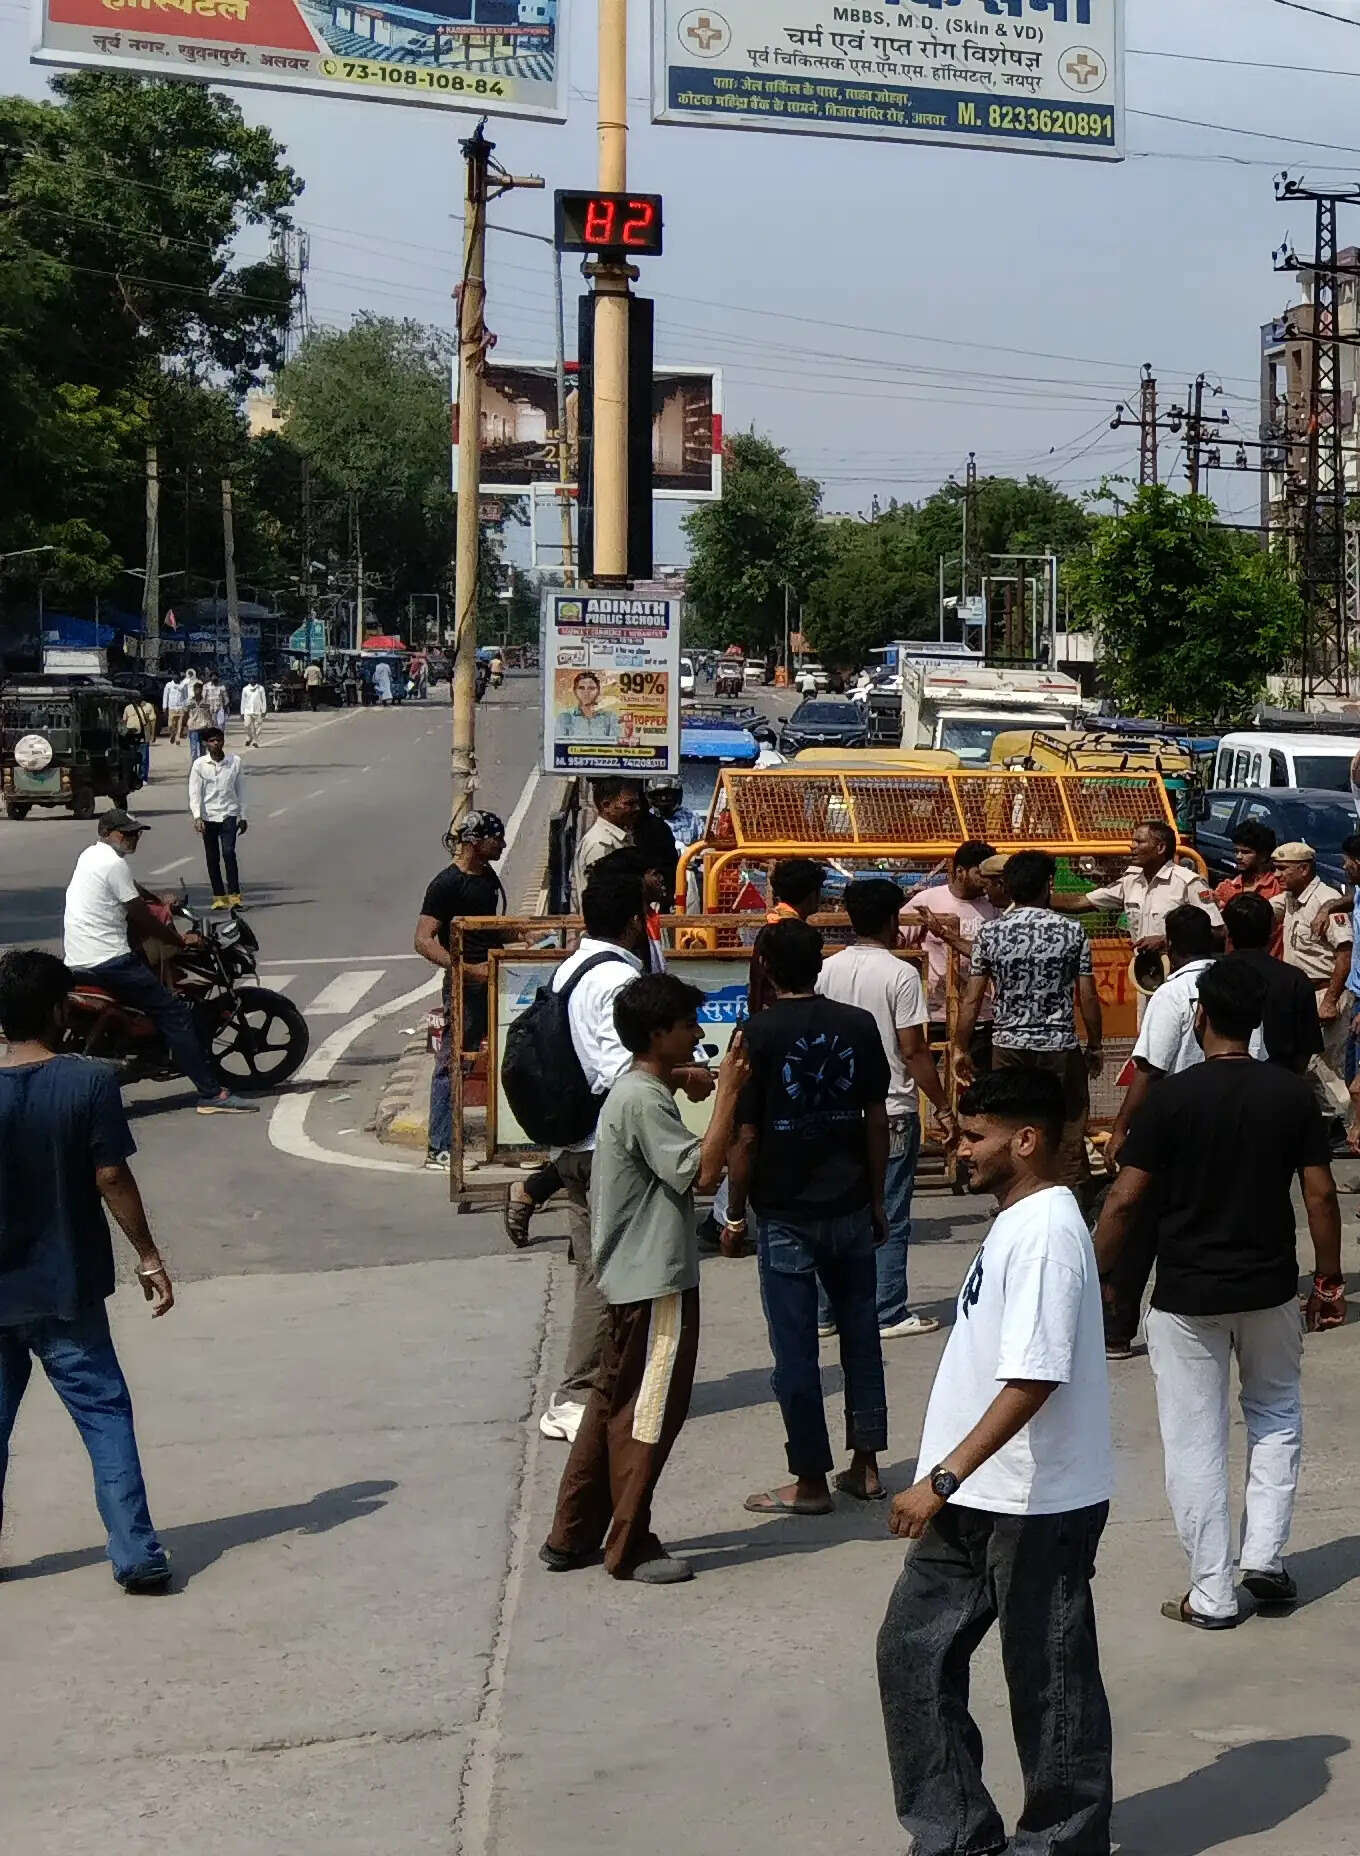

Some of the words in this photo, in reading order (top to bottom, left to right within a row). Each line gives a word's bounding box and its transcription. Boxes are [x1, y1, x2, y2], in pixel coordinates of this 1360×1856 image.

[946, 18, 988, 36] (Skin
[995, 24, 1007, 37] &
[1013, 26, 1044, 43] VD)
[784, 24, 824, 47] चर्म
[830, 30, 865, 55] एवं
[870, 36, 912, 61] गुप्त
[917, 34, 956, 58] रोग
[963, 39, 1043, 73] विशेषज्ञ
[260, 54, 310, 71] अलवर
[747, 46, 769, 67] पूर्व
[773, 48, 845, 71] चिकित्सक
[1002, 73, 1044, 95] जयपुर
[343, 62, 504, 96] 73-108-108-84
[957, 102, 982, 126] M.
[988, 105, 1113, 138] 8233620891
[584, 200, 655, 245] 82
[585, 613, 623, 625] PUBLIC
[625, 615, 666, 626] SCHOOL
[587, 599, 665, 615] ADINATH
[619, 672, 665, 694] 99%
[633, 715, 668, 726] TOPPER
